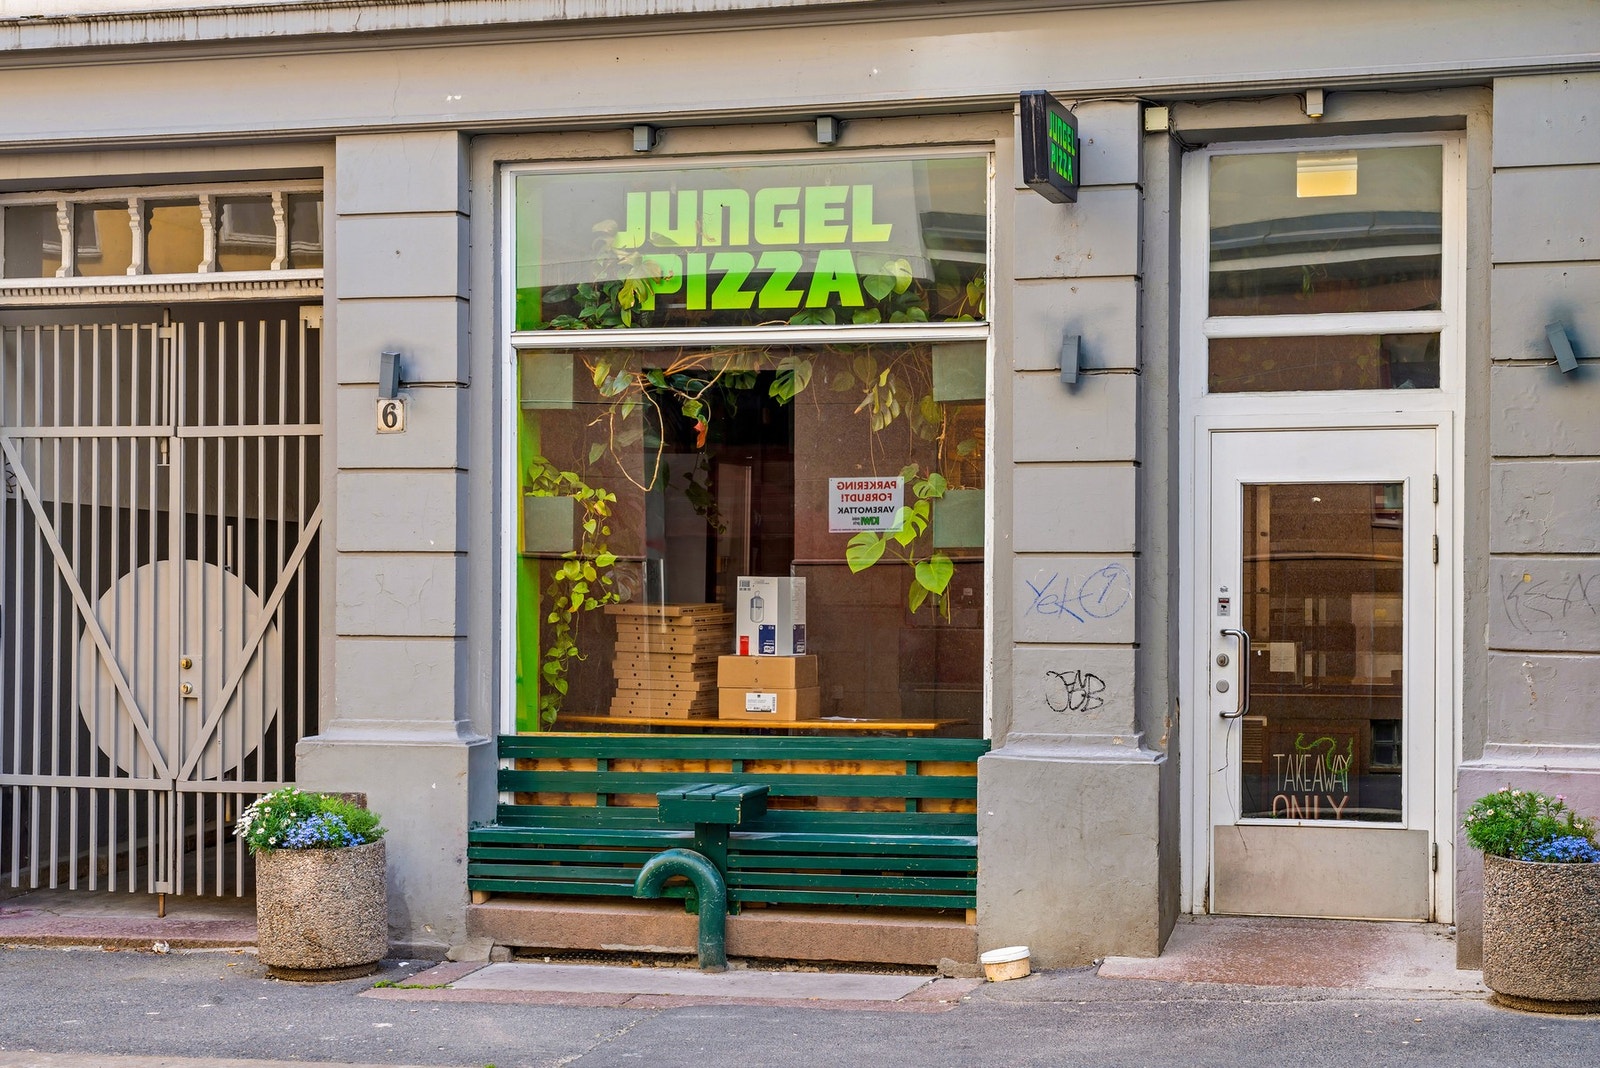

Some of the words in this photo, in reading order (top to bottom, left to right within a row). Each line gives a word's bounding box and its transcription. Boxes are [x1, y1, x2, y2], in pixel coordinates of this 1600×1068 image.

[1049, 110, 1076, 156] JUNGEL
[1050, 141, 1073, 184] PIZZA
[615, 185, 892, 248] JUNGEL
[639, 249, 865, 310] PIZZA
[382, 402, 398, 428] 6
[1272, 753, 1353, 793] TAKEAWAY
